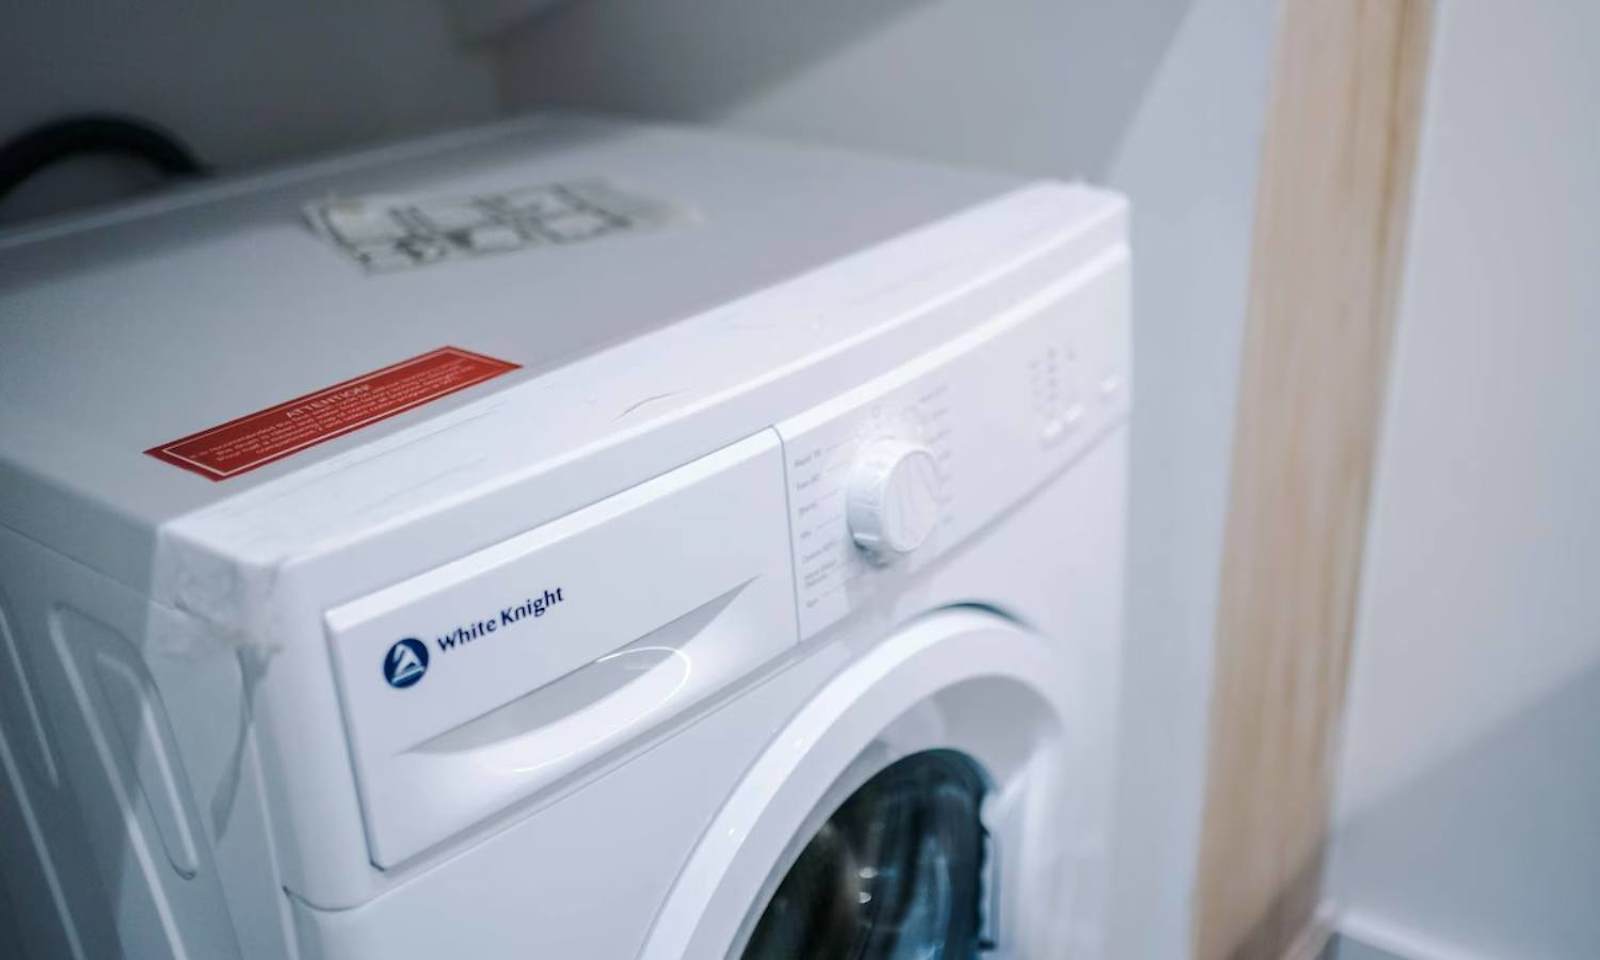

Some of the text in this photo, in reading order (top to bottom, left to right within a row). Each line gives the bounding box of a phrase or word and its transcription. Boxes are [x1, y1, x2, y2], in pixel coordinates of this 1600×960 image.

[286, 384, 370, 419] ATTENTION
[437, 586, 565, 652] White Knight
